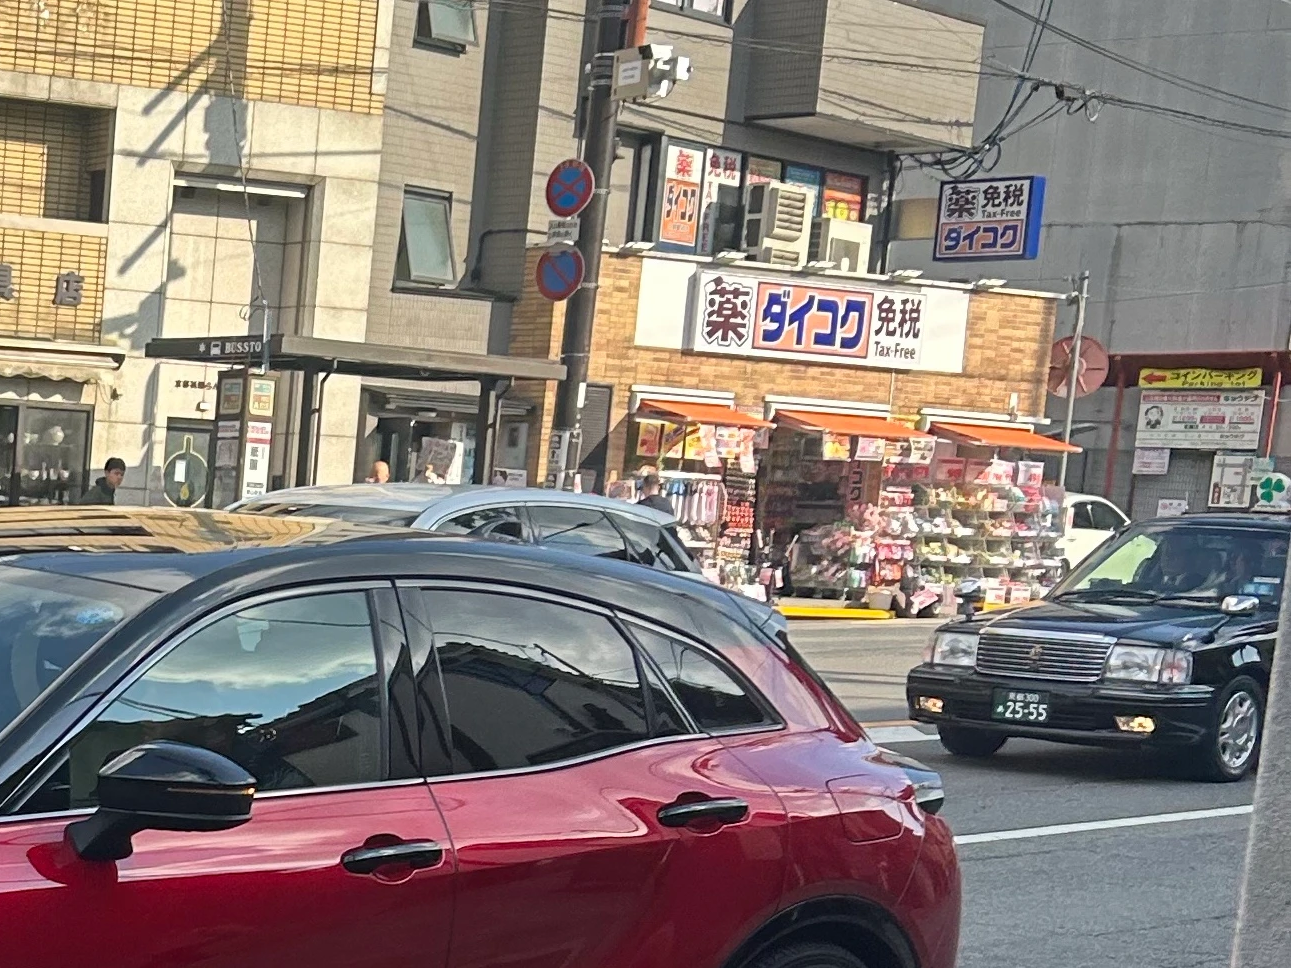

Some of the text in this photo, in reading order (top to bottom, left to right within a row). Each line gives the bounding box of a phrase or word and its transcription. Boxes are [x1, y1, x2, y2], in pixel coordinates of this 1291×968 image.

[945, 183, 1025, 219] 薬 免税
[944, 224, 1019, 252] ダイコク
[705, 275, 922, 350] 薬 ダイコク 免税
[224, 341, 262, 354] BUSSTO
[874, 340, 916, 360] Tax-Free
[1005, 701, 1048, 720] 25-55
